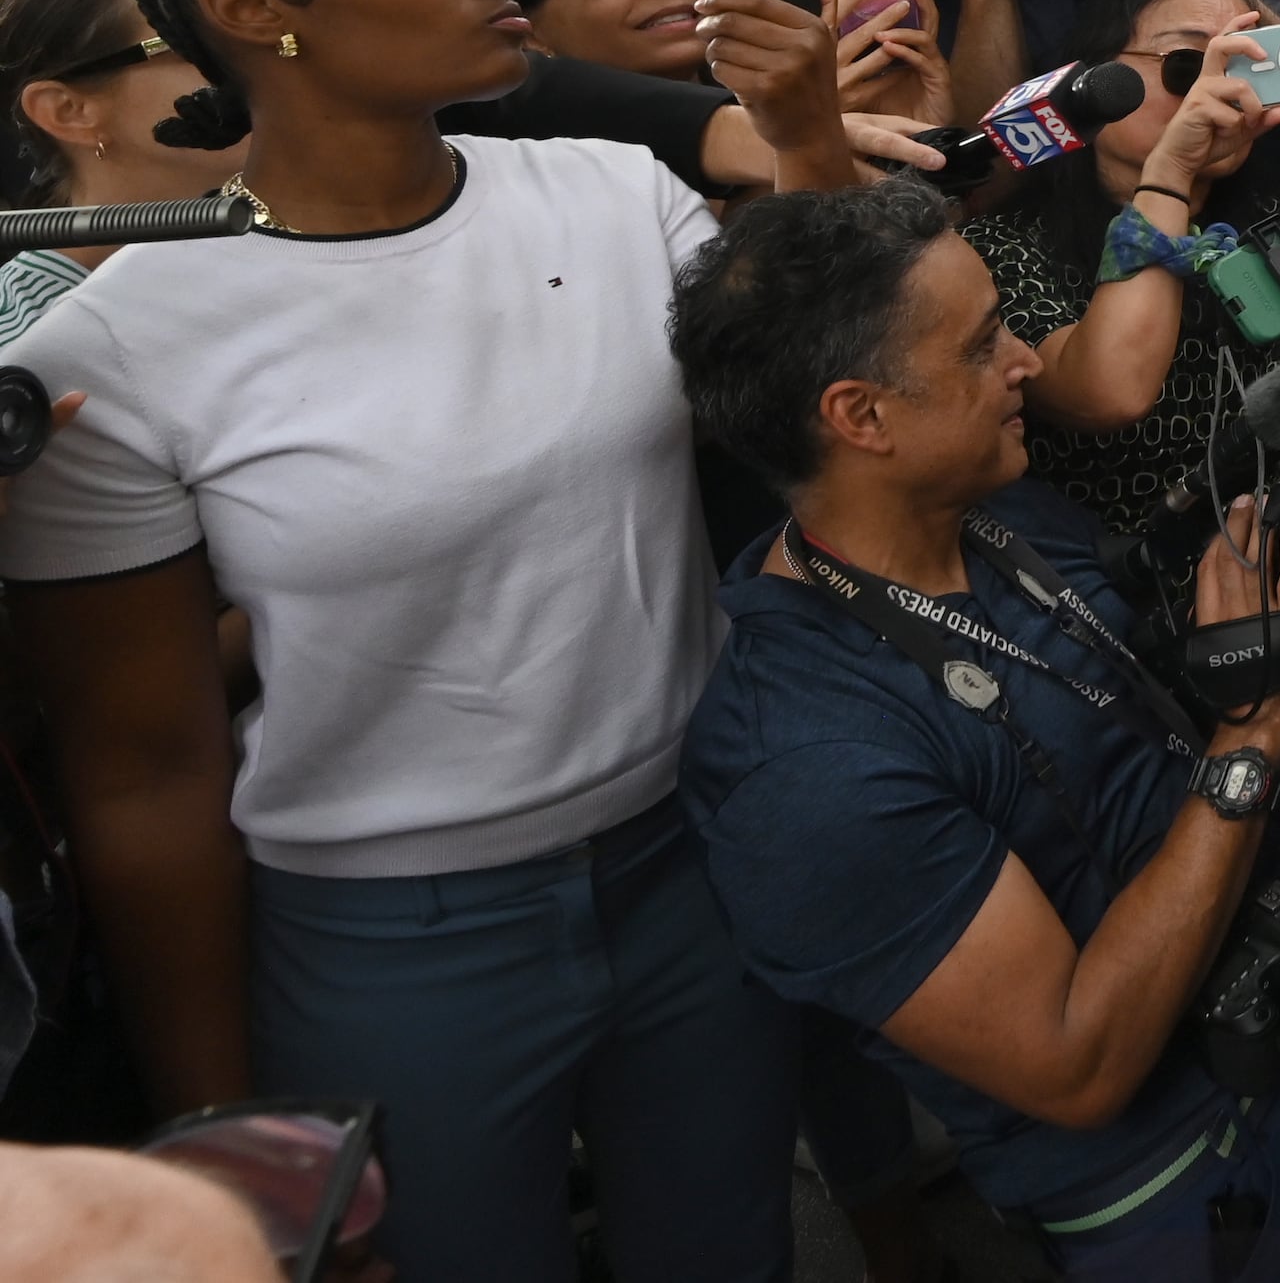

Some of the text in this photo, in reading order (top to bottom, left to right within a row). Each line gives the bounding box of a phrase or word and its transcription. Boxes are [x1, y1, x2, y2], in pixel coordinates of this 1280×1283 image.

[984, 125, 1022, 168] NEWS
[1006, 122, 1053, 154] 5
[1034, 106, 1078, 147] FOX
[963, 507, 1014, 549] PRESS
[808, 557, 860, 600] Nikon
[885, 584, 946, 623] PRESS
[1209, 645, 1265, 667] SONY
